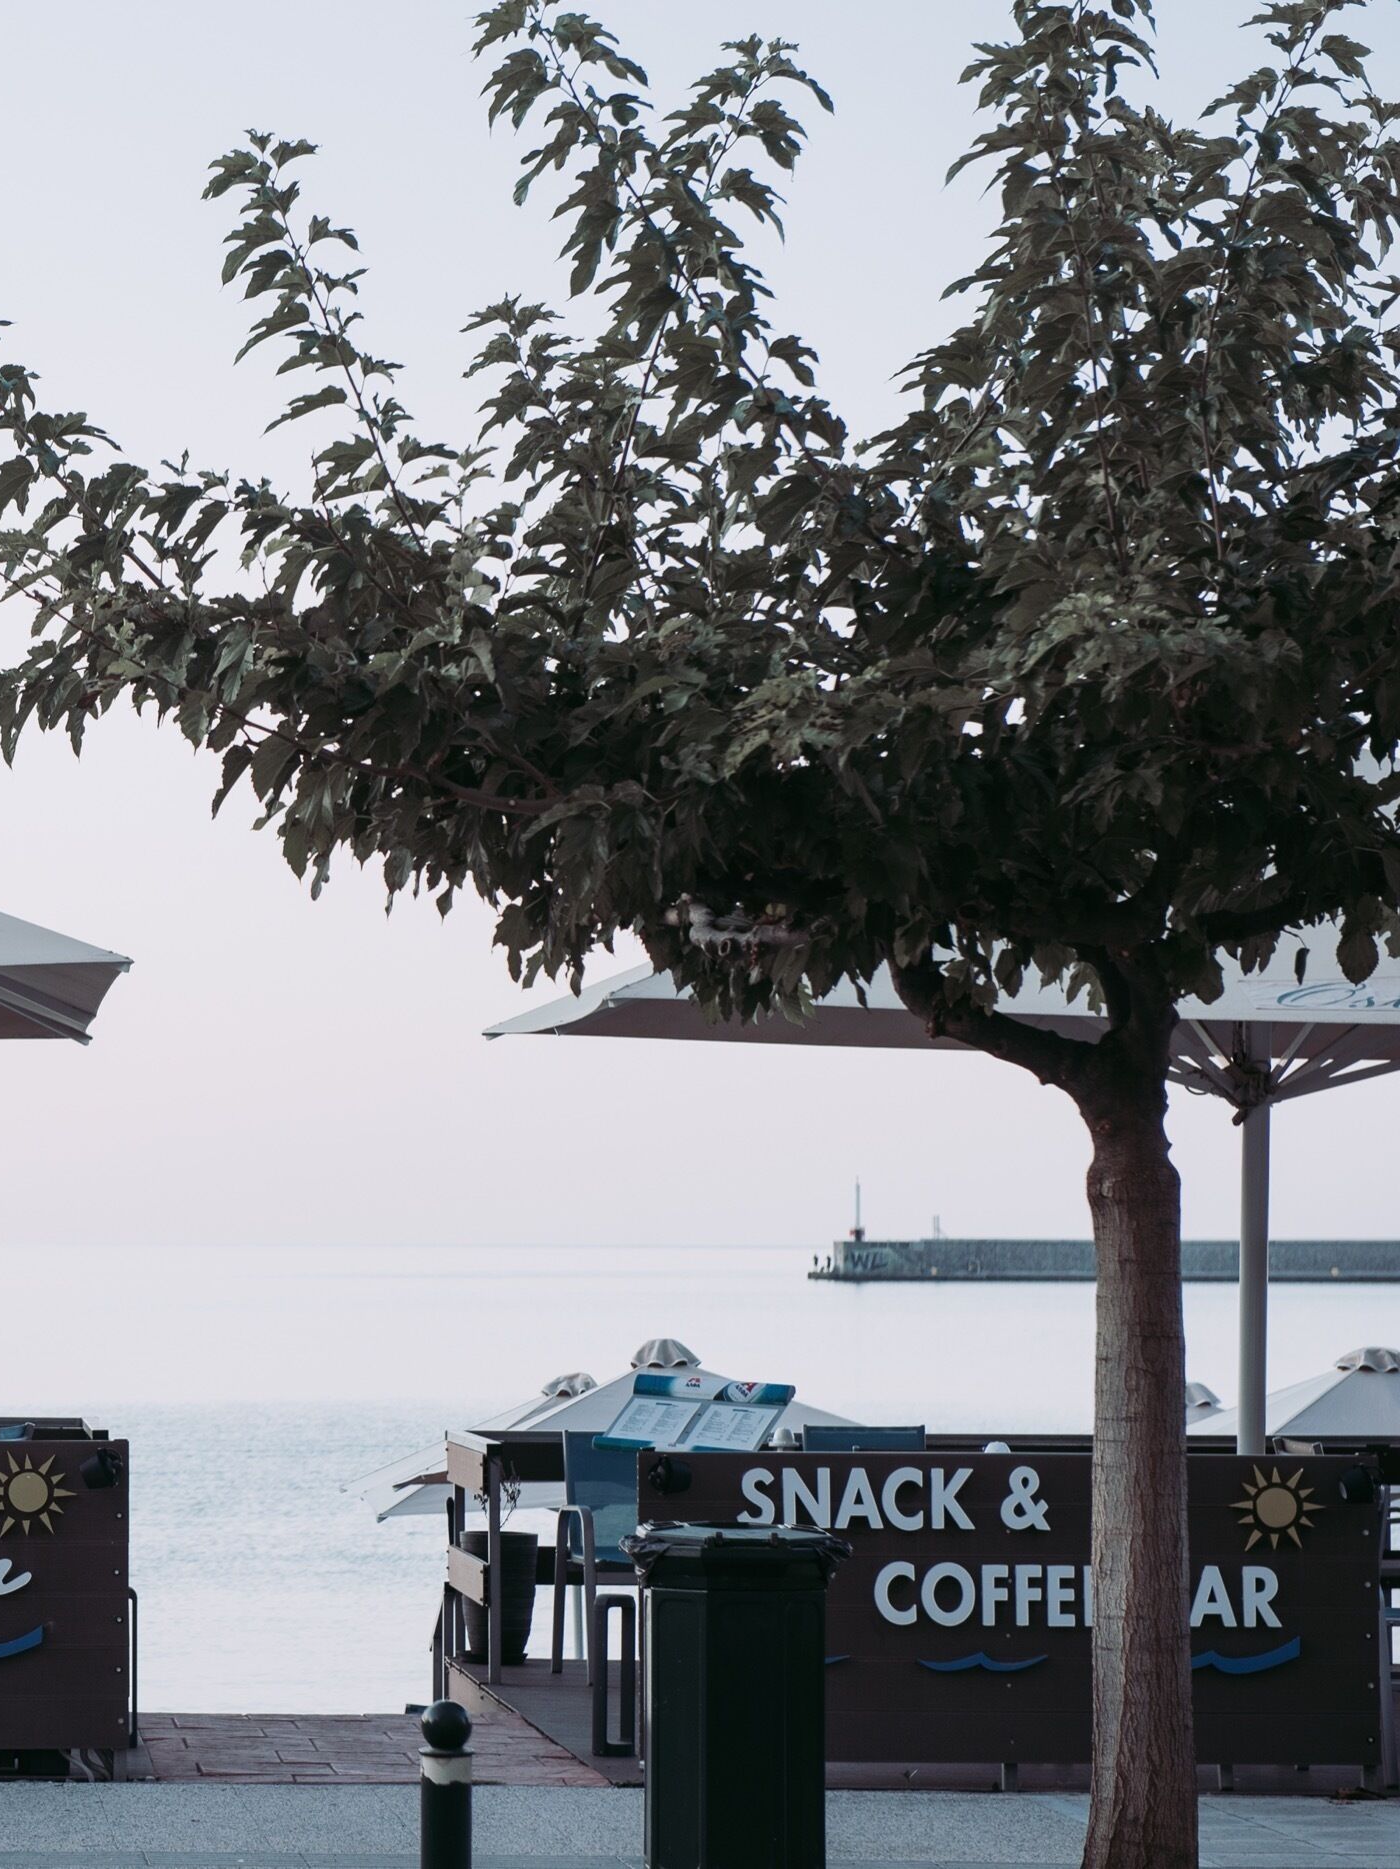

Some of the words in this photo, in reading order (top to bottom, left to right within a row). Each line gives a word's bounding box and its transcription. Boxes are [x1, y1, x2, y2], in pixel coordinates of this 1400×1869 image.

[736, 1467, 976, 1531] SNACK
[1000, 1465, 1051, 1531] &
[1189, 1564, 1283, 1629] AR
